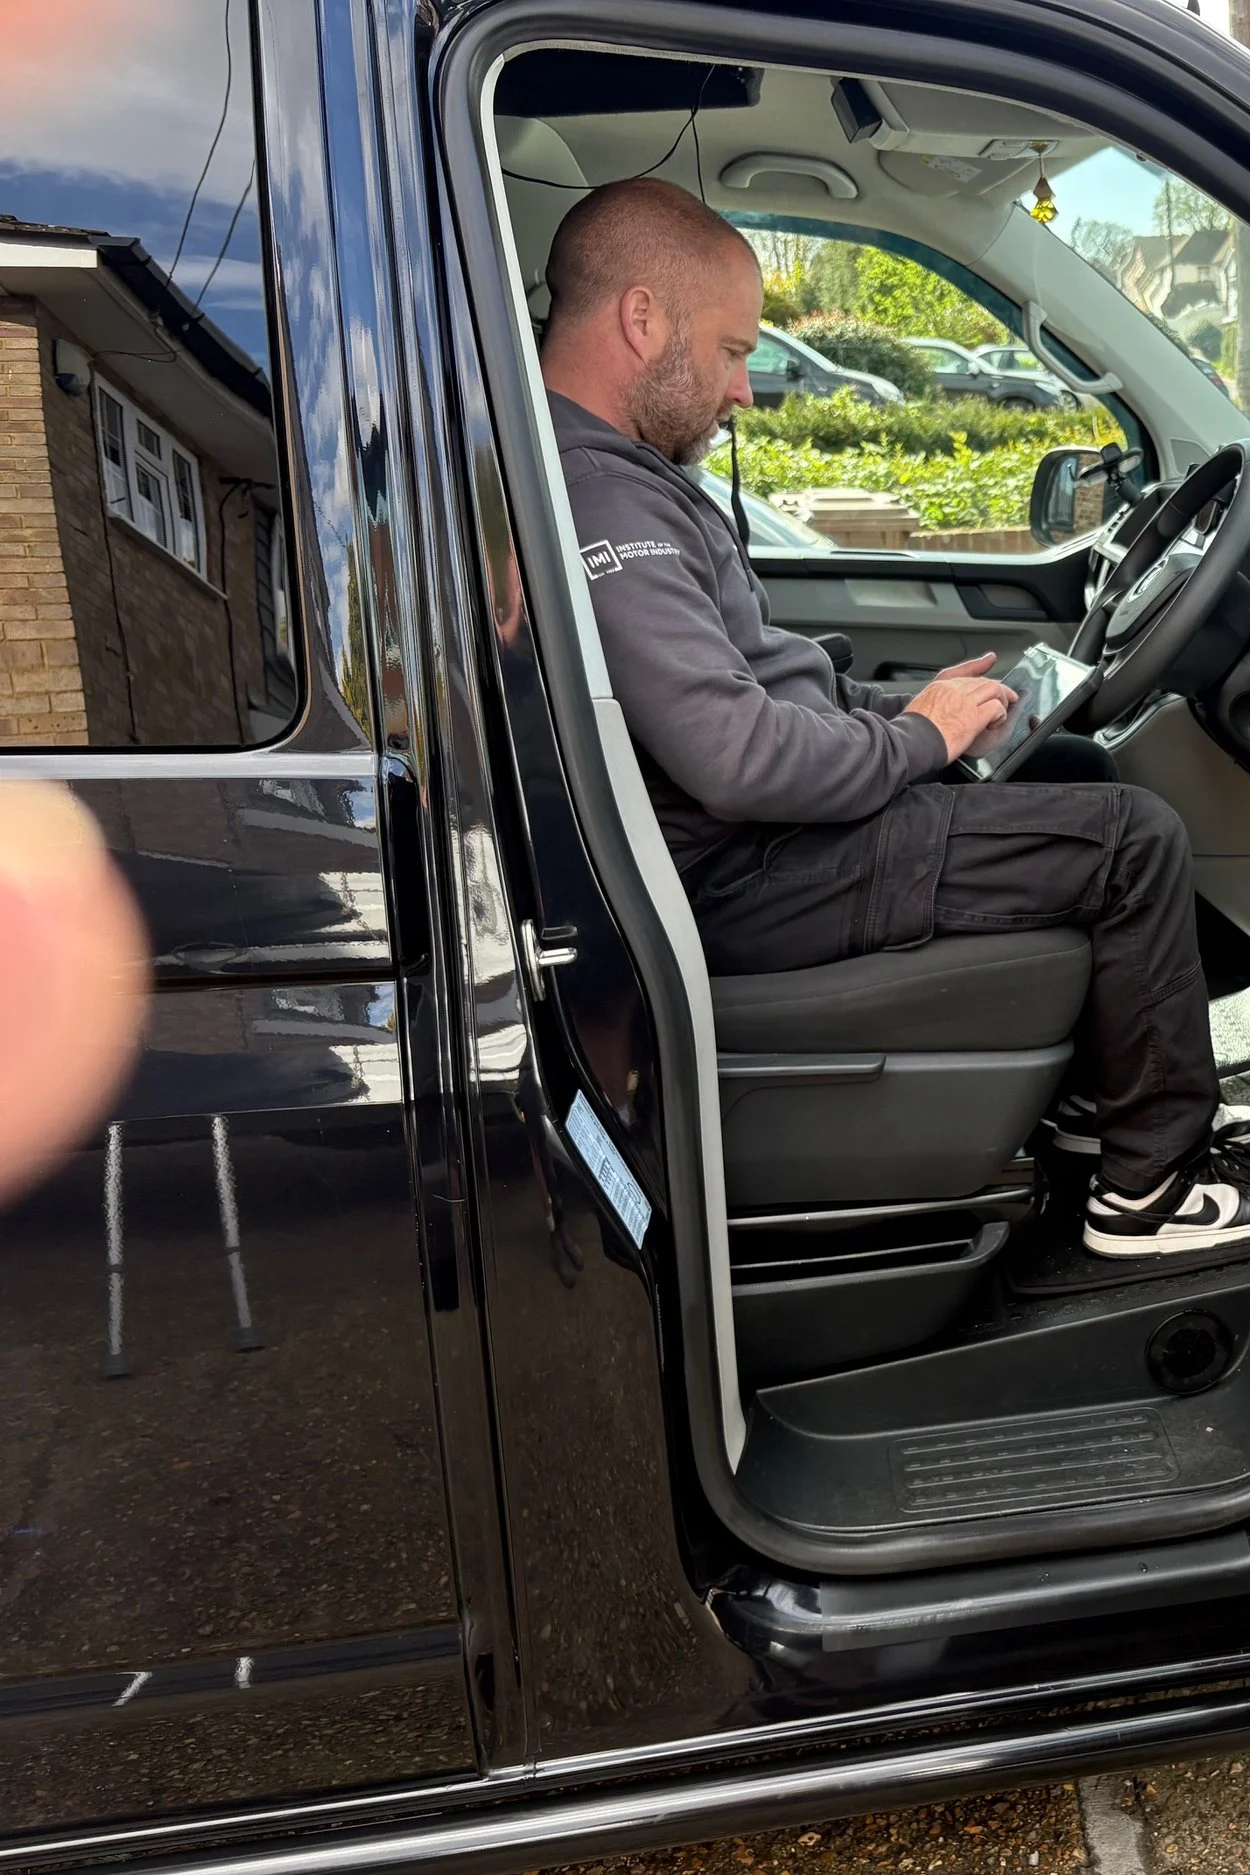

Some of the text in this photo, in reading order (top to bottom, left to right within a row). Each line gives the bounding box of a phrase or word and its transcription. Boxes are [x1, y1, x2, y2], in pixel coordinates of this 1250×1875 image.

[616, 541, 656, 553] INSTITUTE
[587, 550, 612, 569] IMI
[619, 548, 681, 560] MOTOR INDUSTRY
